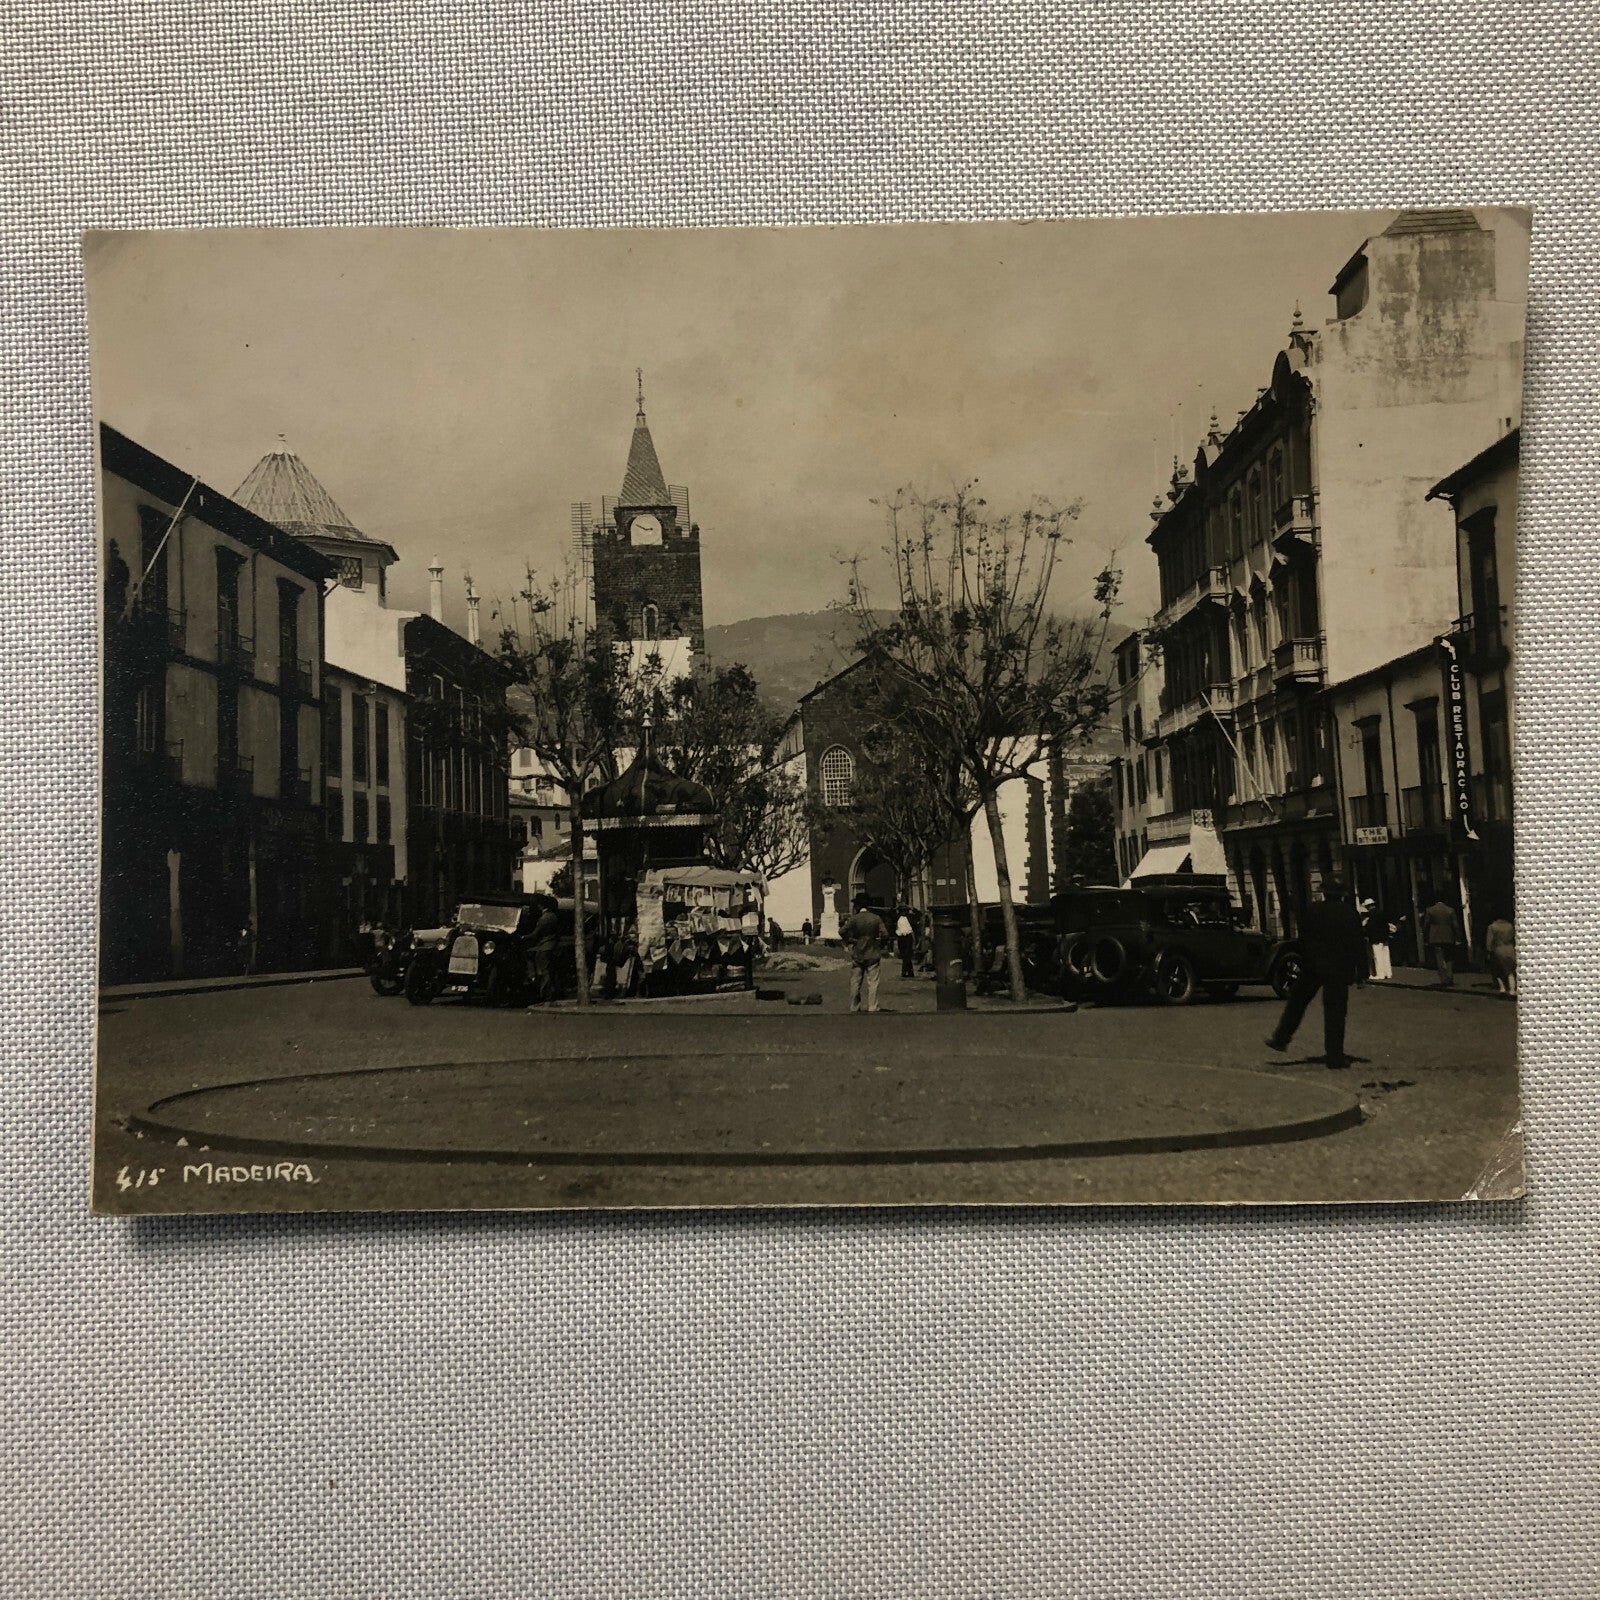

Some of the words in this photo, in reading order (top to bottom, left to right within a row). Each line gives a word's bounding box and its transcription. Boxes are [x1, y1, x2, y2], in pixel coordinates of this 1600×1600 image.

[1450, 664, 1461, 700] CLUB
[1361, 828, 1383, 837] THE
[183, 1162, 316, 1185] MADEIRA
